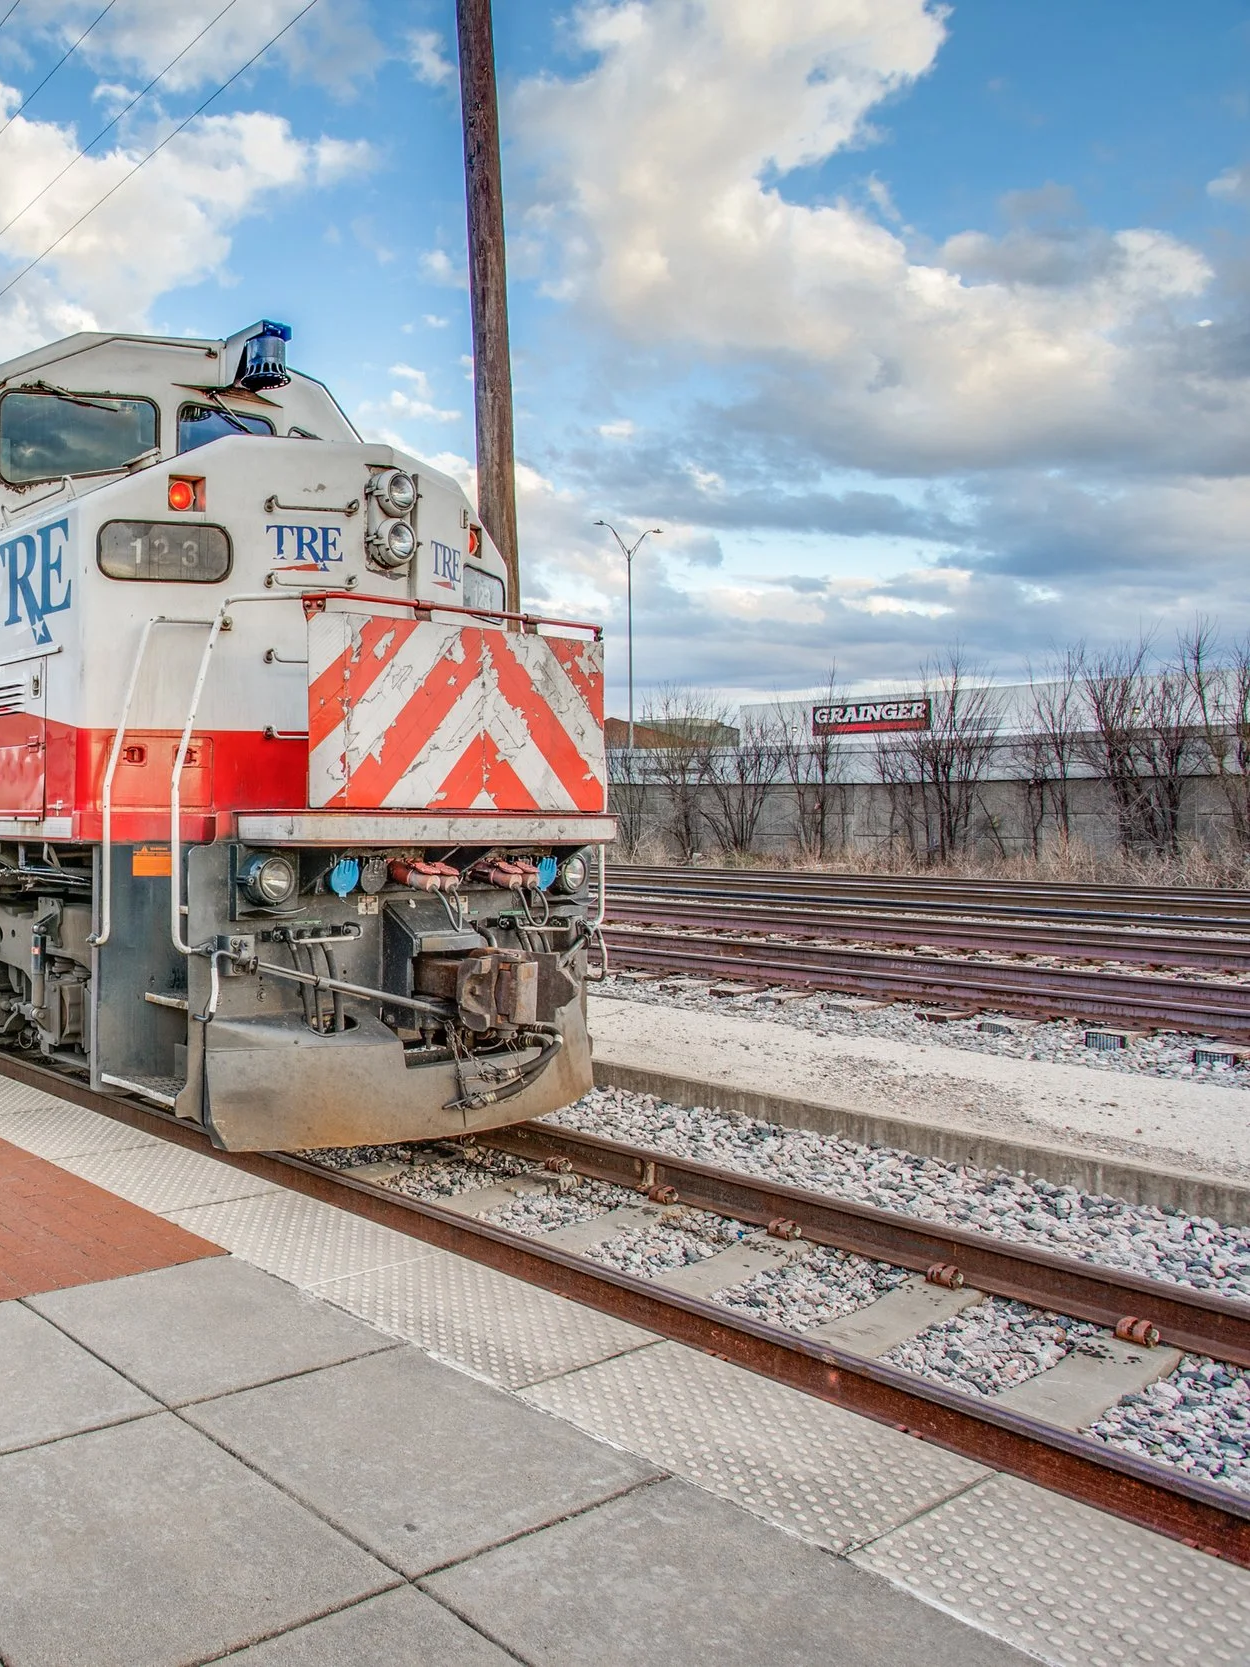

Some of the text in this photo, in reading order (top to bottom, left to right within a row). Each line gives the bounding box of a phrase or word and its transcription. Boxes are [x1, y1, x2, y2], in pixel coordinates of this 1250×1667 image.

[130, 537, 199, 568] 123
[266, 524, 343, 571] TRE
[431, 540, 461, 590] TRE
[814, 702, 926, 724] GRAINGER
